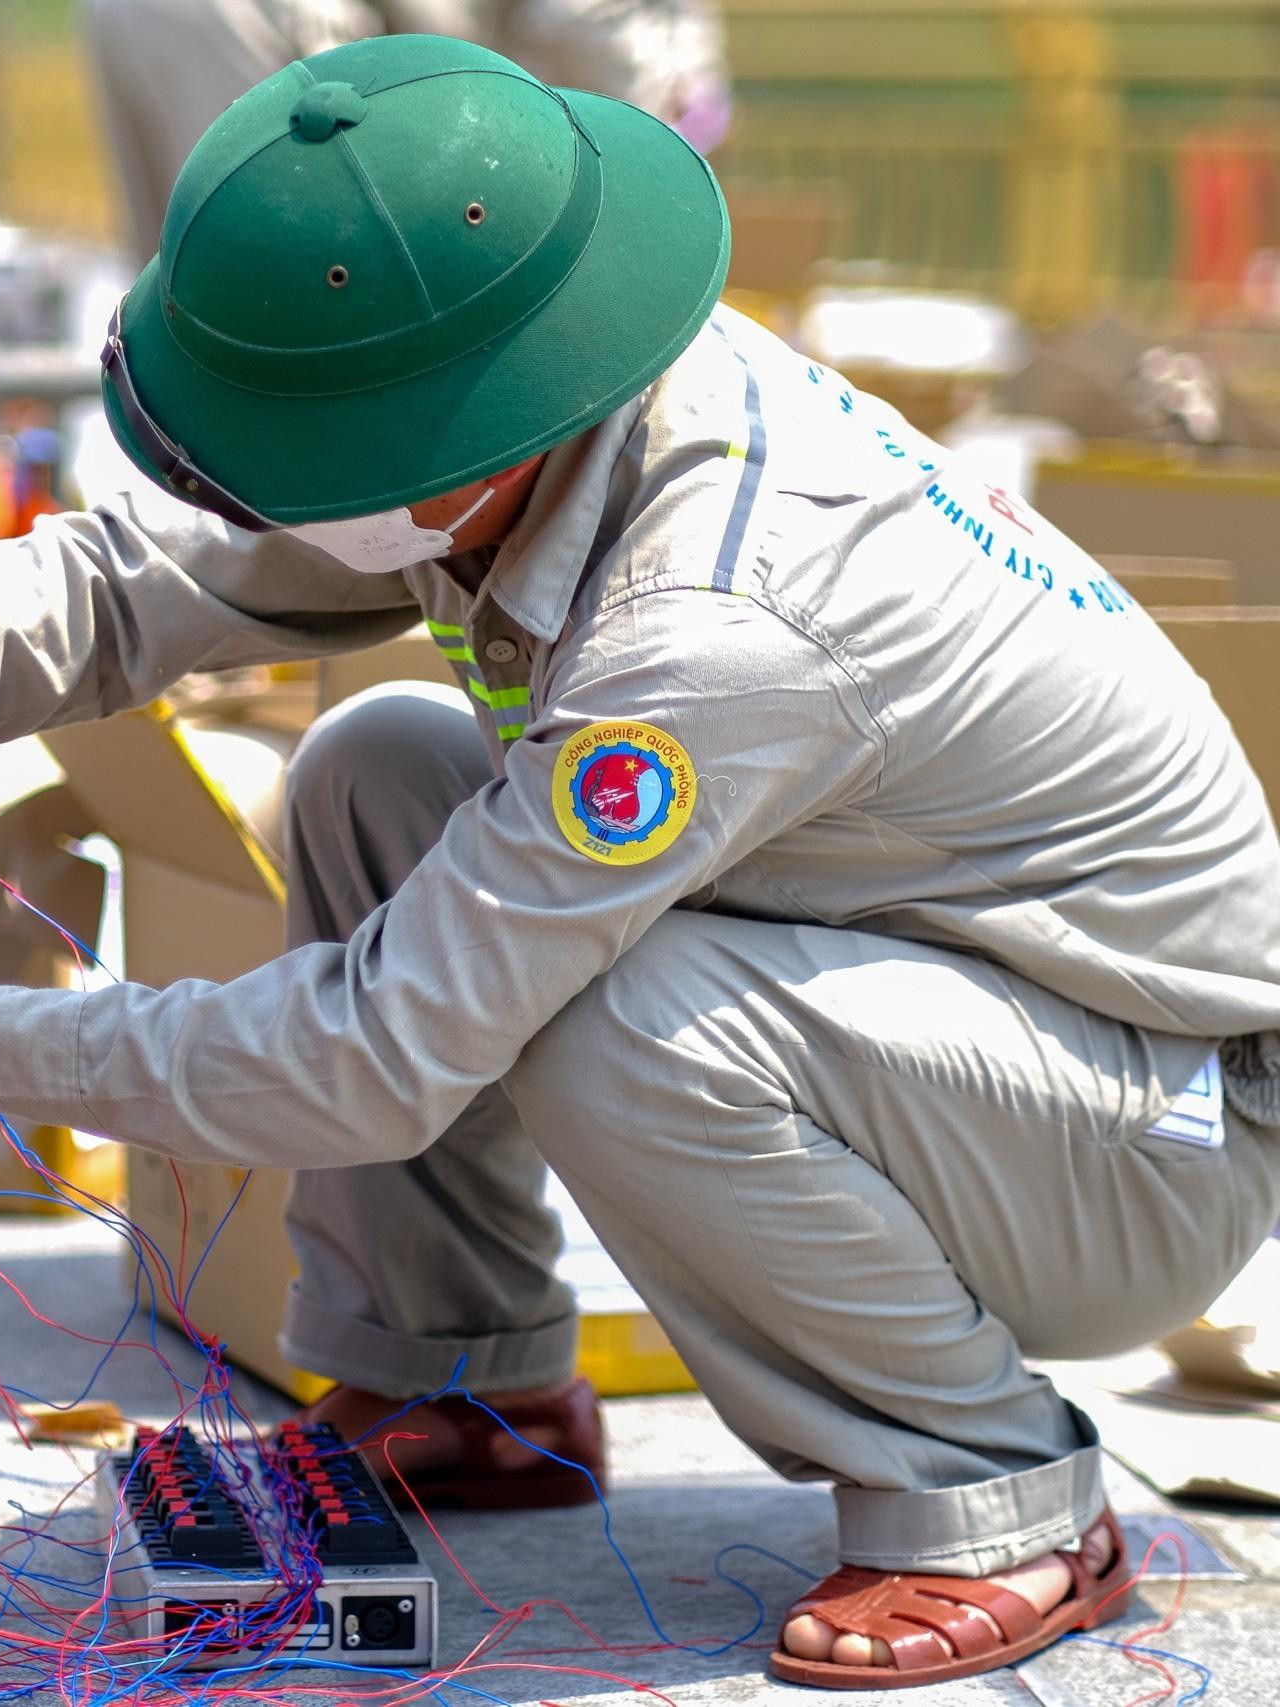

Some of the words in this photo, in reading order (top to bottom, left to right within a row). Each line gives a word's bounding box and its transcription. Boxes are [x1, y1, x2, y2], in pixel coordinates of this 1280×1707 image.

[925, 483, 994, 557] TNHH
[1005, 547, 1053, 590] CTY
[565, 738, 592, 768] CÔNG
[593, 727, 644, 744] NGHIỆP
[646, 734, 679, 764] QUỐC
[582, 836, 613, 857] Z121
